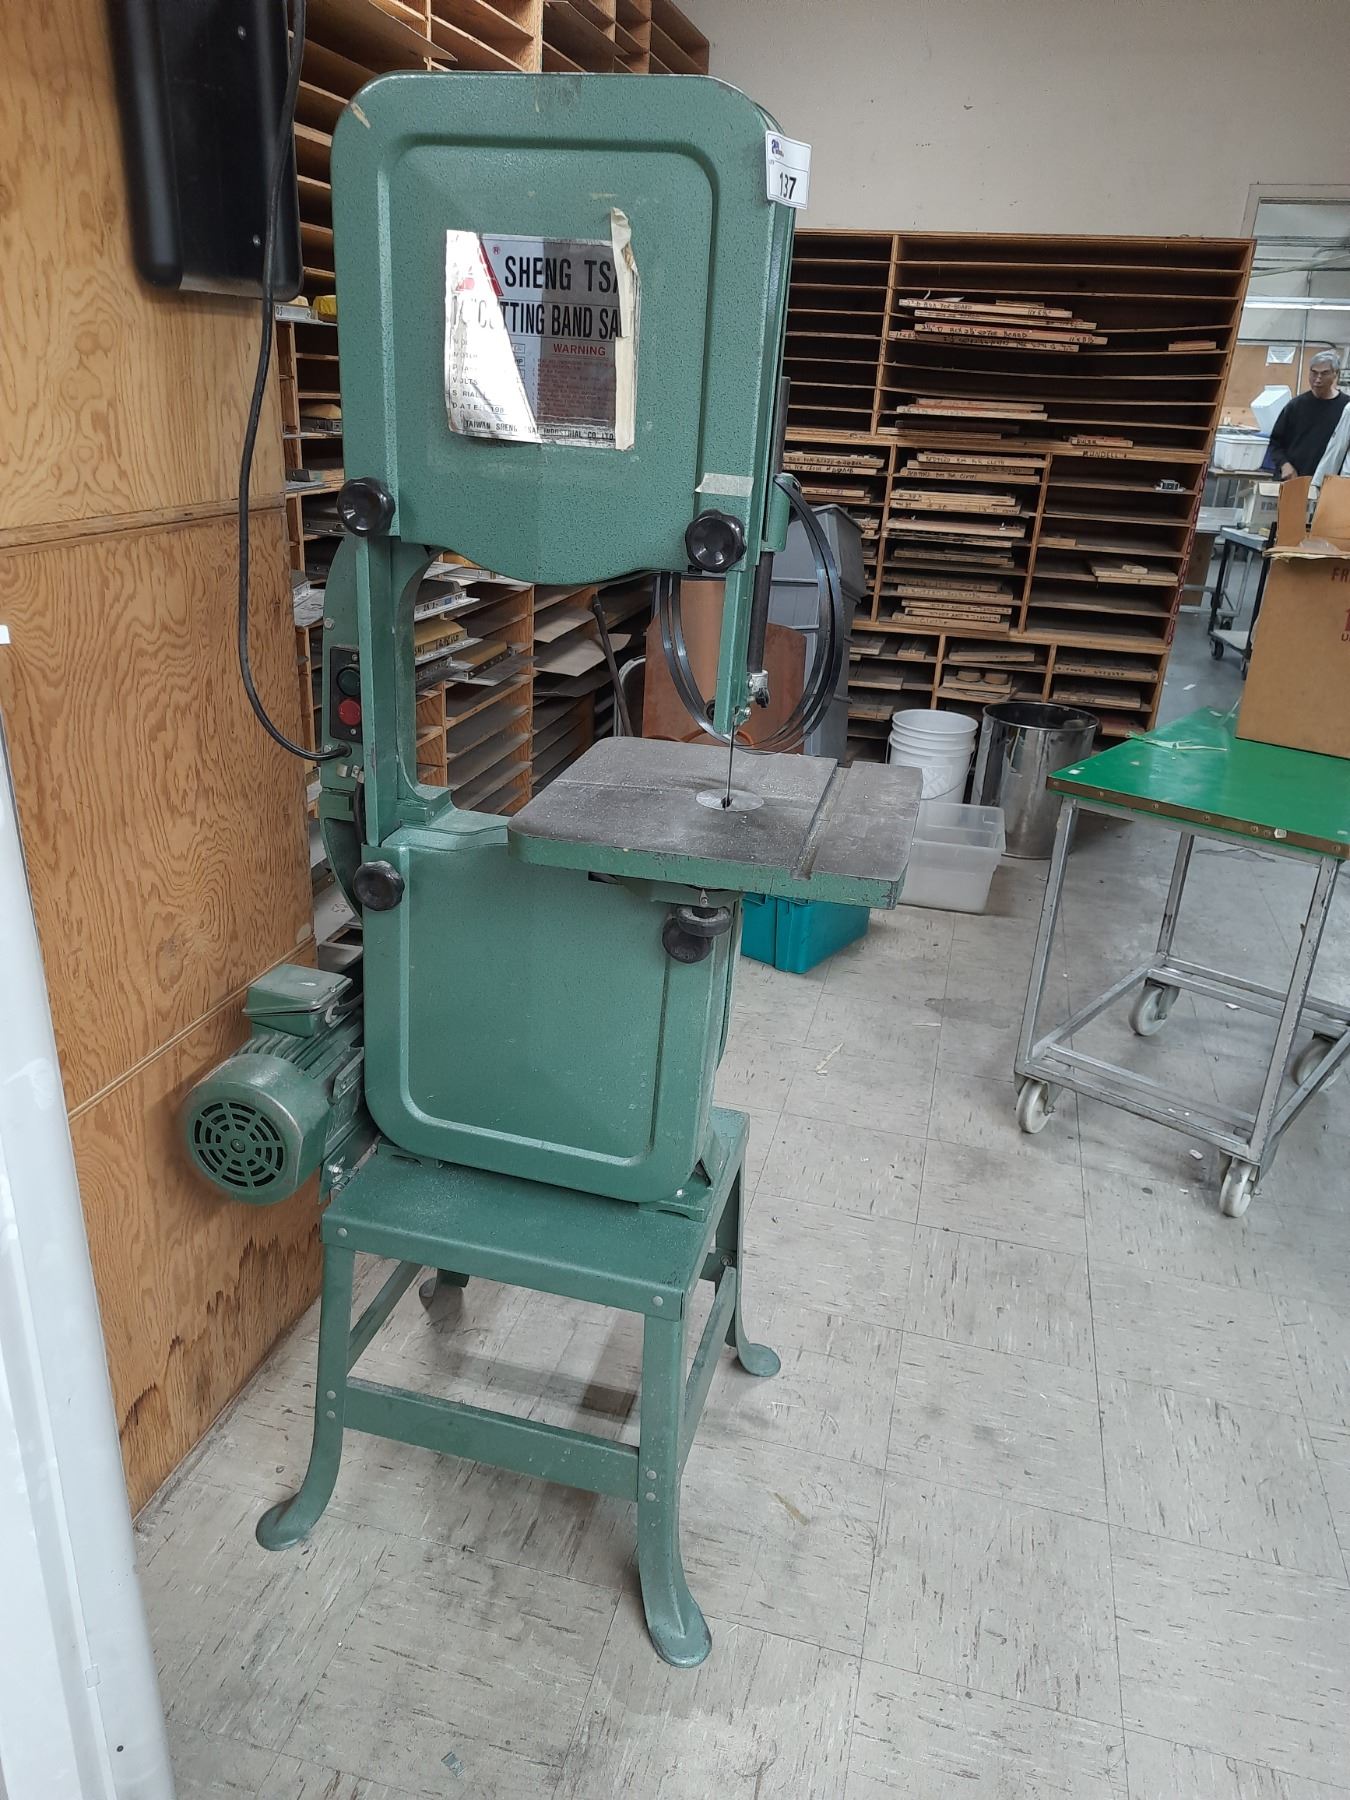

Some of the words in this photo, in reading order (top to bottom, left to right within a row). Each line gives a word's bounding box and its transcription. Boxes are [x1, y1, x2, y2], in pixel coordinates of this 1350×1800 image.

[780, 171, 797, 200] 137
[504, 255, 571, 291] SHENG
[551, 303, 593, 338] BAND
[599, 308, 622, 341] SA
[553, 343, 606, 356] WARNING
